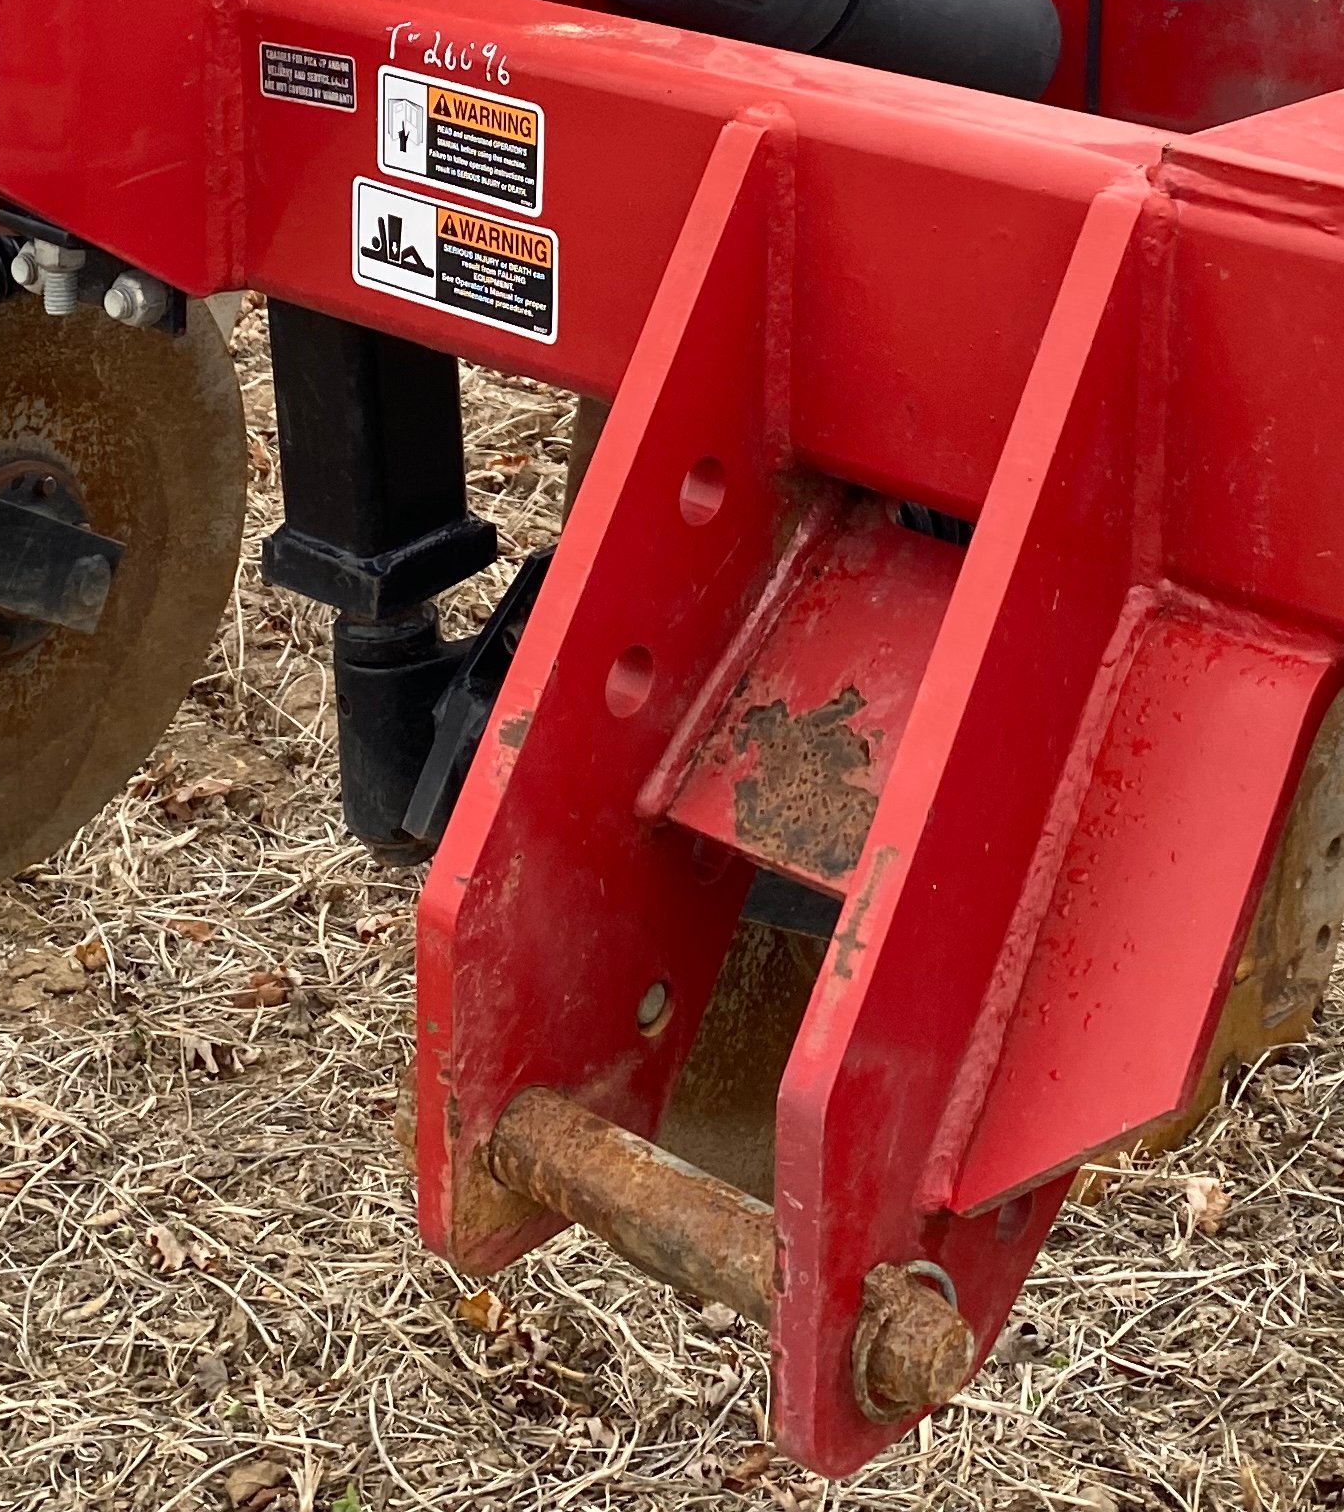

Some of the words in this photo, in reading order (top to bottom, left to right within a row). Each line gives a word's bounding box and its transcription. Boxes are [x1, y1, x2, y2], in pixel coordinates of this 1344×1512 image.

[294, 69, 306, 80] AND
[453, 97, 532, 139] WARNING
[437, 124, 453, 136] READ
[453, 130, 463, 139] and
[463, 133, 493, 147] understand
[493, 140, 528, 157] OPERATOR'S
[437, 137, 460, 151] MANUAL
[460, 144, 477, 156] before
[477, 150, 492, 162] using
[492, 153, 503, 163] this
[503, 157, 527, 170] machine.
[428, 148, 447, 161] Failure
[446, 153, 453, 162] to
[453, 154, 469, 167] follow
[469, 160, 494, 176] operating
[493, 166, 525, 183] instructions
[524, 176, 535, 186] can
[435, 164, 451, 175] result
[456, 168, 481, 183] SERIOUS
[481, 176, 501, 189] INJURY
[500, 183, 508, 191] or
[507, 183, 528, 197] DEATH.
[459, 217, 548, 264] WARNING
[443, 243, 474, 259] SERIOUS
[474, 252, 499, 267] INJURY
[500, 261, 508, 269] or
[508, 262, 532, 276] DEATH
[532, 271, 546, 280] can
[461, 259, 481, 271] result
[481, 264, 497, 276] from
[497, 269, 527, 285] FALLING
[441, 272, 454, 283] See
[455, 276, 489, 294] Operator's
[489, 286, 513, 301] Manual
[513, 294, 524, 304] for
[524, 298, 547, 311] proper
[473, 272, 515, 292] EQUIPMENT.
[453, 287, 495, 305] maintenance
[494, 300, 534, 317] procedures.
